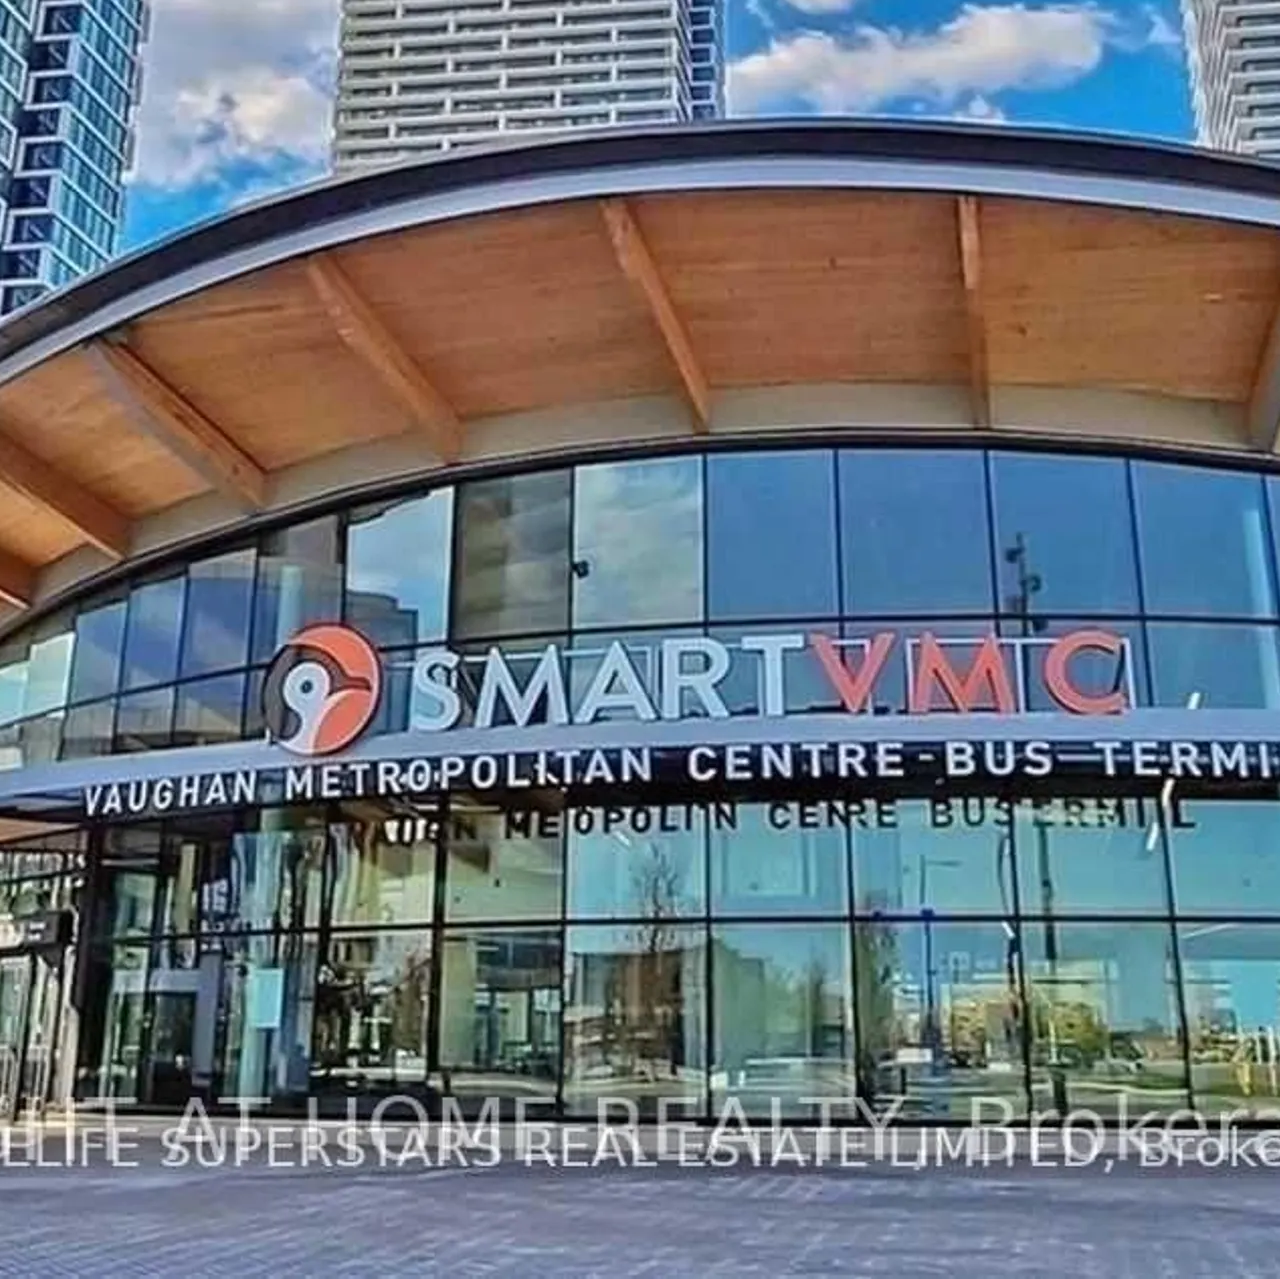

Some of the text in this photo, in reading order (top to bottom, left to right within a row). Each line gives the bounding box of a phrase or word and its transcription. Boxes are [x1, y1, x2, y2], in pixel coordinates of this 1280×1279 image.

[85, 767, 257, 816] VAUGHAN
[286, 748, 650, 799] METROPOLITAN
[689, 743, 906, 782] CENTRE
[945, 741, 1054, 777] BUS
